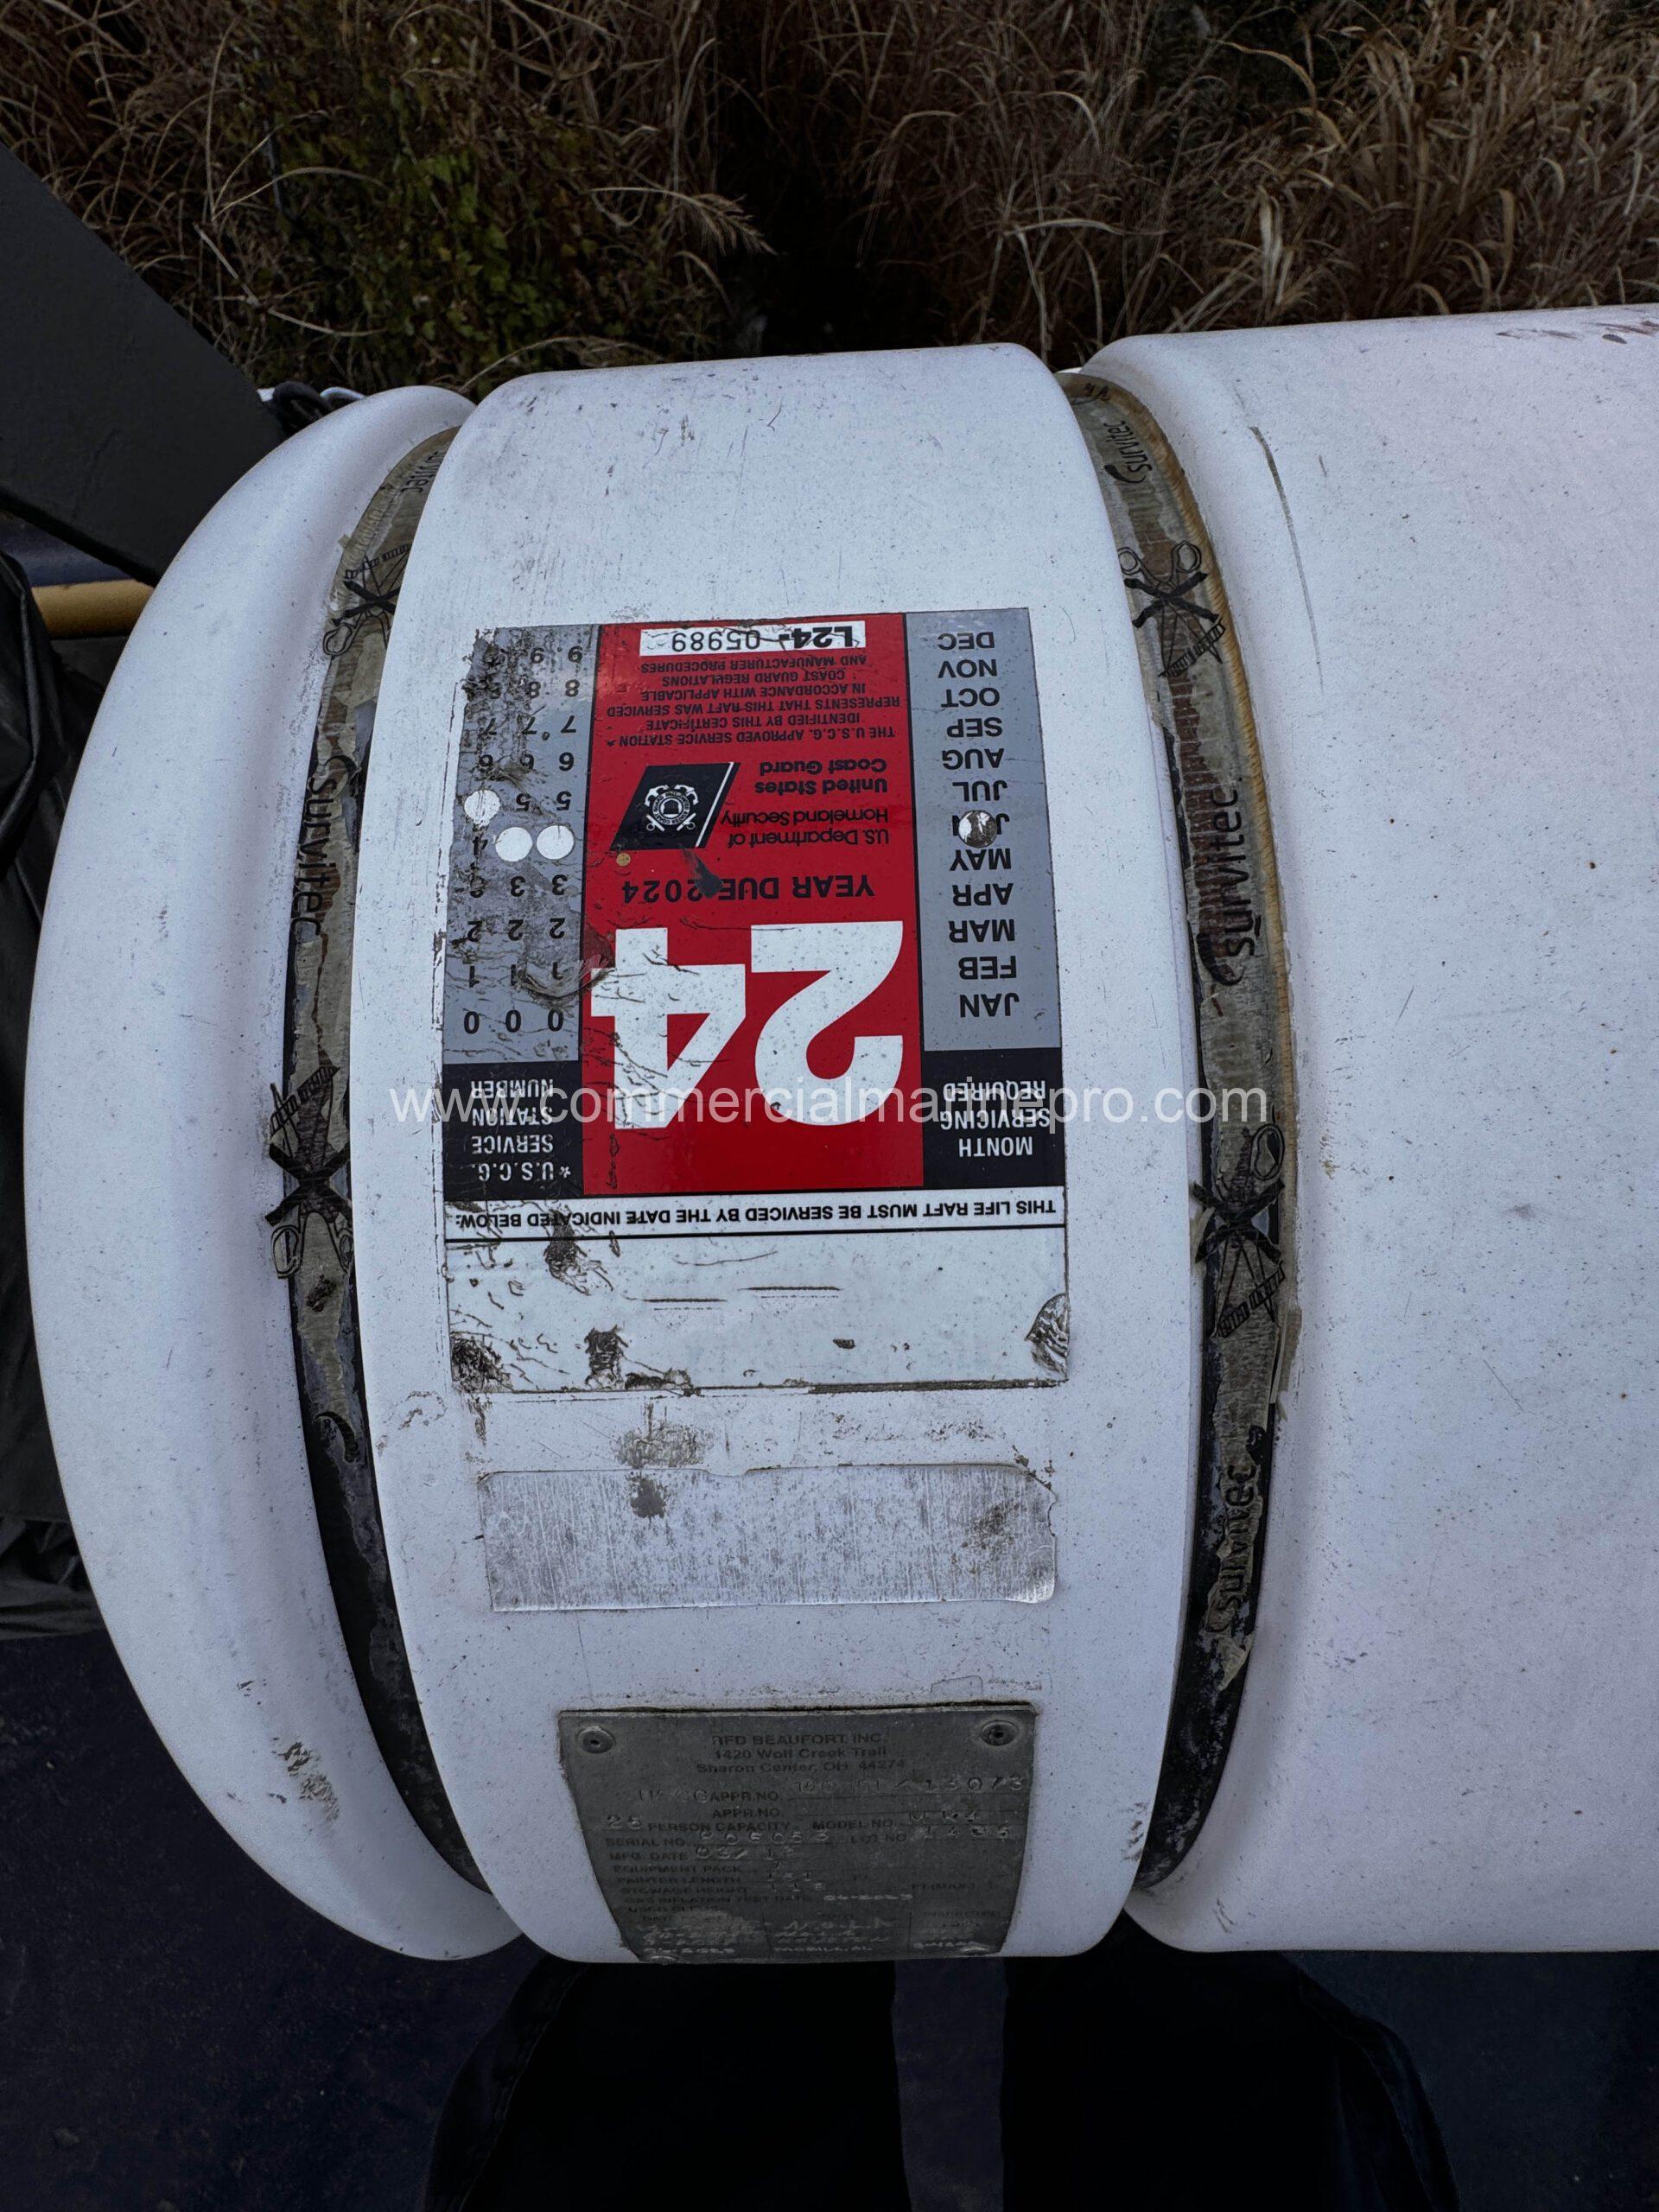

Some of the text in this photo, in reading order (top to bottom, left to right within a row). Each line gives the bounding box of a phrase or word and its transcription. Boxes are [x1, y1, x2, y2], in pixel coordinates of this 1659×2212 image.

[1103, 421, 1153, 473] survitec
[938, 632, 995, 650] DEC
[531, 646, 583, 664] 9 9
[641, 655, 867, 672] AND MANUFACTURER PROCEDURES
[662, 670, 845, 686] COAST GUARD REGULATIONS
[938, 659, 997, 678] NOV
[528, 679, 580, 698] 8 8
[641, 683, 865, 701] IN ACCORDANCE WITH APPLICABLE
[941, 688, 1000, 707] OCT
[607, 696, 899, 717] REPRESENTS THAT THIS RAFT WAS SERVICED
[483, 715, 576, 735] 7 7 7
[646, 713, 859, 730] IDENTIFIED BY THIS CERTIFICATE
[947, 717, 1002, 738] SEP
[620, 726, 895, 747] THE U.S.C.G. APPROVED SERVICE STATION
[479, 753, 574, 772] 6 6 6
[760, 759, 887, 776] Coast Guard
[942, 748, 1004, 770] AUG
[755, 779, 887, 796] United States
[952, 780, 1007, 801] JUL
[516, 791, 572, 811] 5 5
[721, 808, 888, 826] Homeland Security
[728, 828, 889, 848] U.S. Department of
[289, 777, 337, 937] survitec
[950, 849, 1011, 871] MAY
[1209, 789, 1255, 957] survitec
[511, 876, 525, 897] 3
[552, 874, 568, 895] 3
[622, 874, 874, 904] YEAR DUE 2024
[952, 883, 1013, 906] APR
[467, 918, 565, 942] 2 2 2
[949, 919, 1015, 943] MAR
[469, 963, 563, 988] 1 1 1
[958, 956, 1016, 980] FEB
[960, 993, 1020, 1017] JAN
[464, 1010, 563, 1034] 0 0 0
[591, 921, 903, 1129] 24
[471, 1079, 553, 1098] NUMBER
[944, 1080, 1046, 1101] REQUIRED
[472, 1106, 553, 1125] STATION
[940, 1108, 1050, 1129] SERVICING
[472, 1135, 553, 1154] SERVICE
[959, 1137, 1033, 1157] MONTH
[472, 1161, 554, 1180] U.S.C.G.
[456, 1200, 1056, 1228] THIS LIFE RAFT MUST BE SERVICED BY THE DATE INDICATED BELOW:
[712, 1735, 747, 1745] RFD
[753, 1734, 847, 1745] BEAUFORT
[715, 1750, 752, 1759] 1420
[798, 1748, 845, 1758] Creek
[696, 1764, 753, 1773] Sharon
[649, 1821, 710, 1832] PERSON
[715, 1821, 790, 1832] CAPACITY
[607, 1838, 658, 1847] SERIAL
